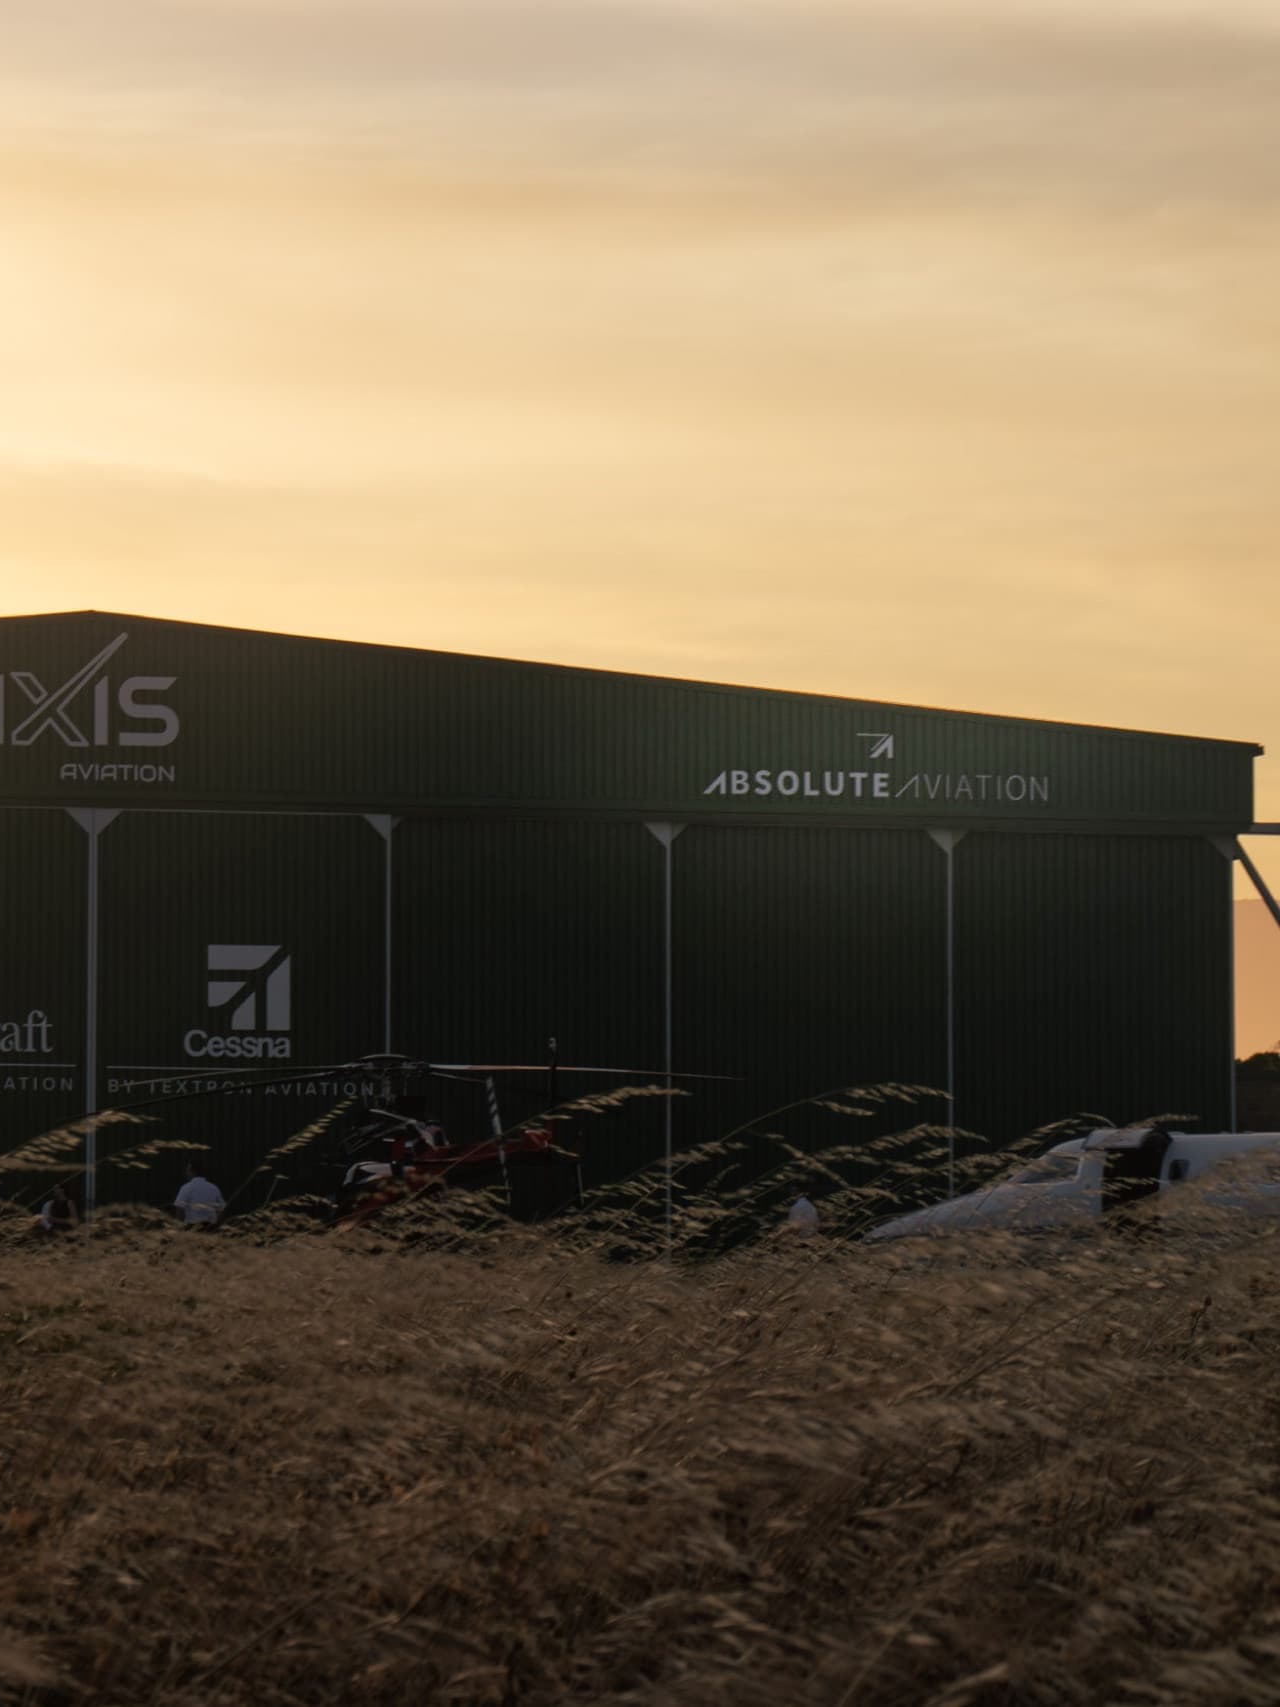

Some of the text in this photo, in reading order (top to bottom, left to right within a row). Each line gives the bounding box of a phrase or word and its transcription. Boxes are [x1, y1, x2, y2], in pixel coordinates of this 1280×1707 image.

[59, 762, 175, 782] AVIATION
[704, 770, 1049, 801] ABSOLUTE AVIATION
[183, 1029, 291, 1058] Cessna
[107, 1079, 134, 1094] BY
